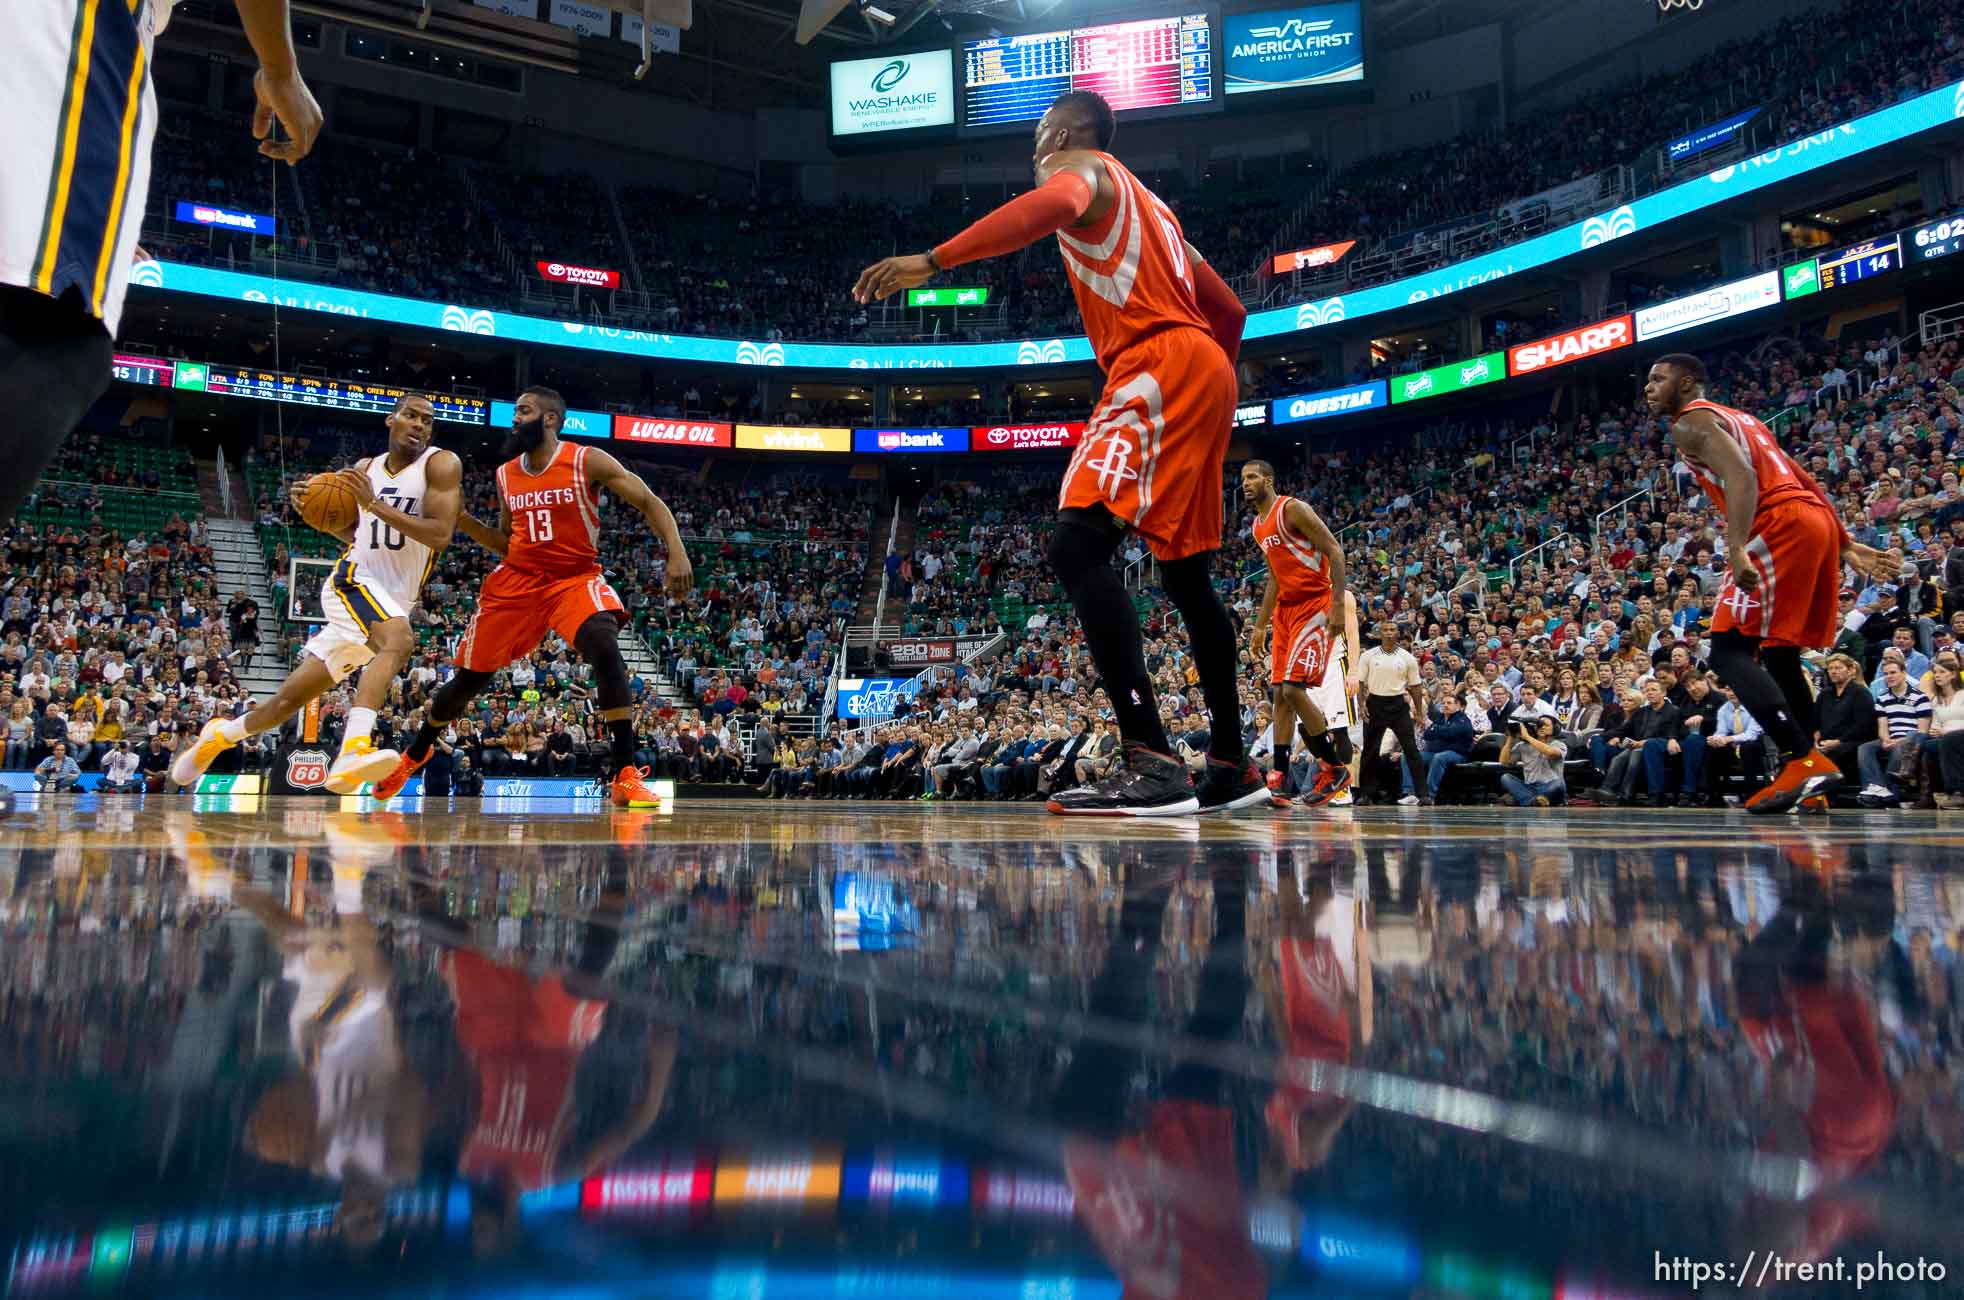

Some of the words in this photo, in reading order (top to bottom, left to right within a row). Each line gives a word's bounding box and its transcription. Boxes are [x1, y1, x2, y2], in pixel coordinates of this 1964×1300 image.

[1231, 38, 1304, 58] AMERICA
[1306, 32, 1354, 50] FIRST
[1259, 53, 1292, 63] CREDIT
[1297, 49, 1326, 59] UNION
[848, 92, 937, 111] WASHAKIE
[193, 207, 257, 229] usbank
[1914, 218, 1964, 247] 6:02
[1843, 242, 1875, 258] JAZZ
[1924, 246, 1945, 258] QTR
[1953, 241, 1960, 249] 1
[1868, 254, 1890, 272] 14
[566, 267, 609, 282] TOYOTA
[112, 366, 130, 379] 15
[211, 374, 228, 383] UTA
[439, 396, 452, 404] STL
[1289, 390, 1375, 418] QUESTAR
[563, 416, 585, 431] KIN
[630, 421, 685, 440] LUCAS
[688, 426, 715, 442] OIL
[878, 432, 945, 449] usbank
[1010, 427, 1070, 441] TOYOTA
[509, 487, 574, 512] ROCKETS
[525, 509, 554, 542] 13
[370, 518, 406, 551] 10
[929, 647, 951, 658] ZONE
[956, 641, 974, 650] HOME
[974, 641, 982, 649] OF
[294, 766, 321, 781] 66
